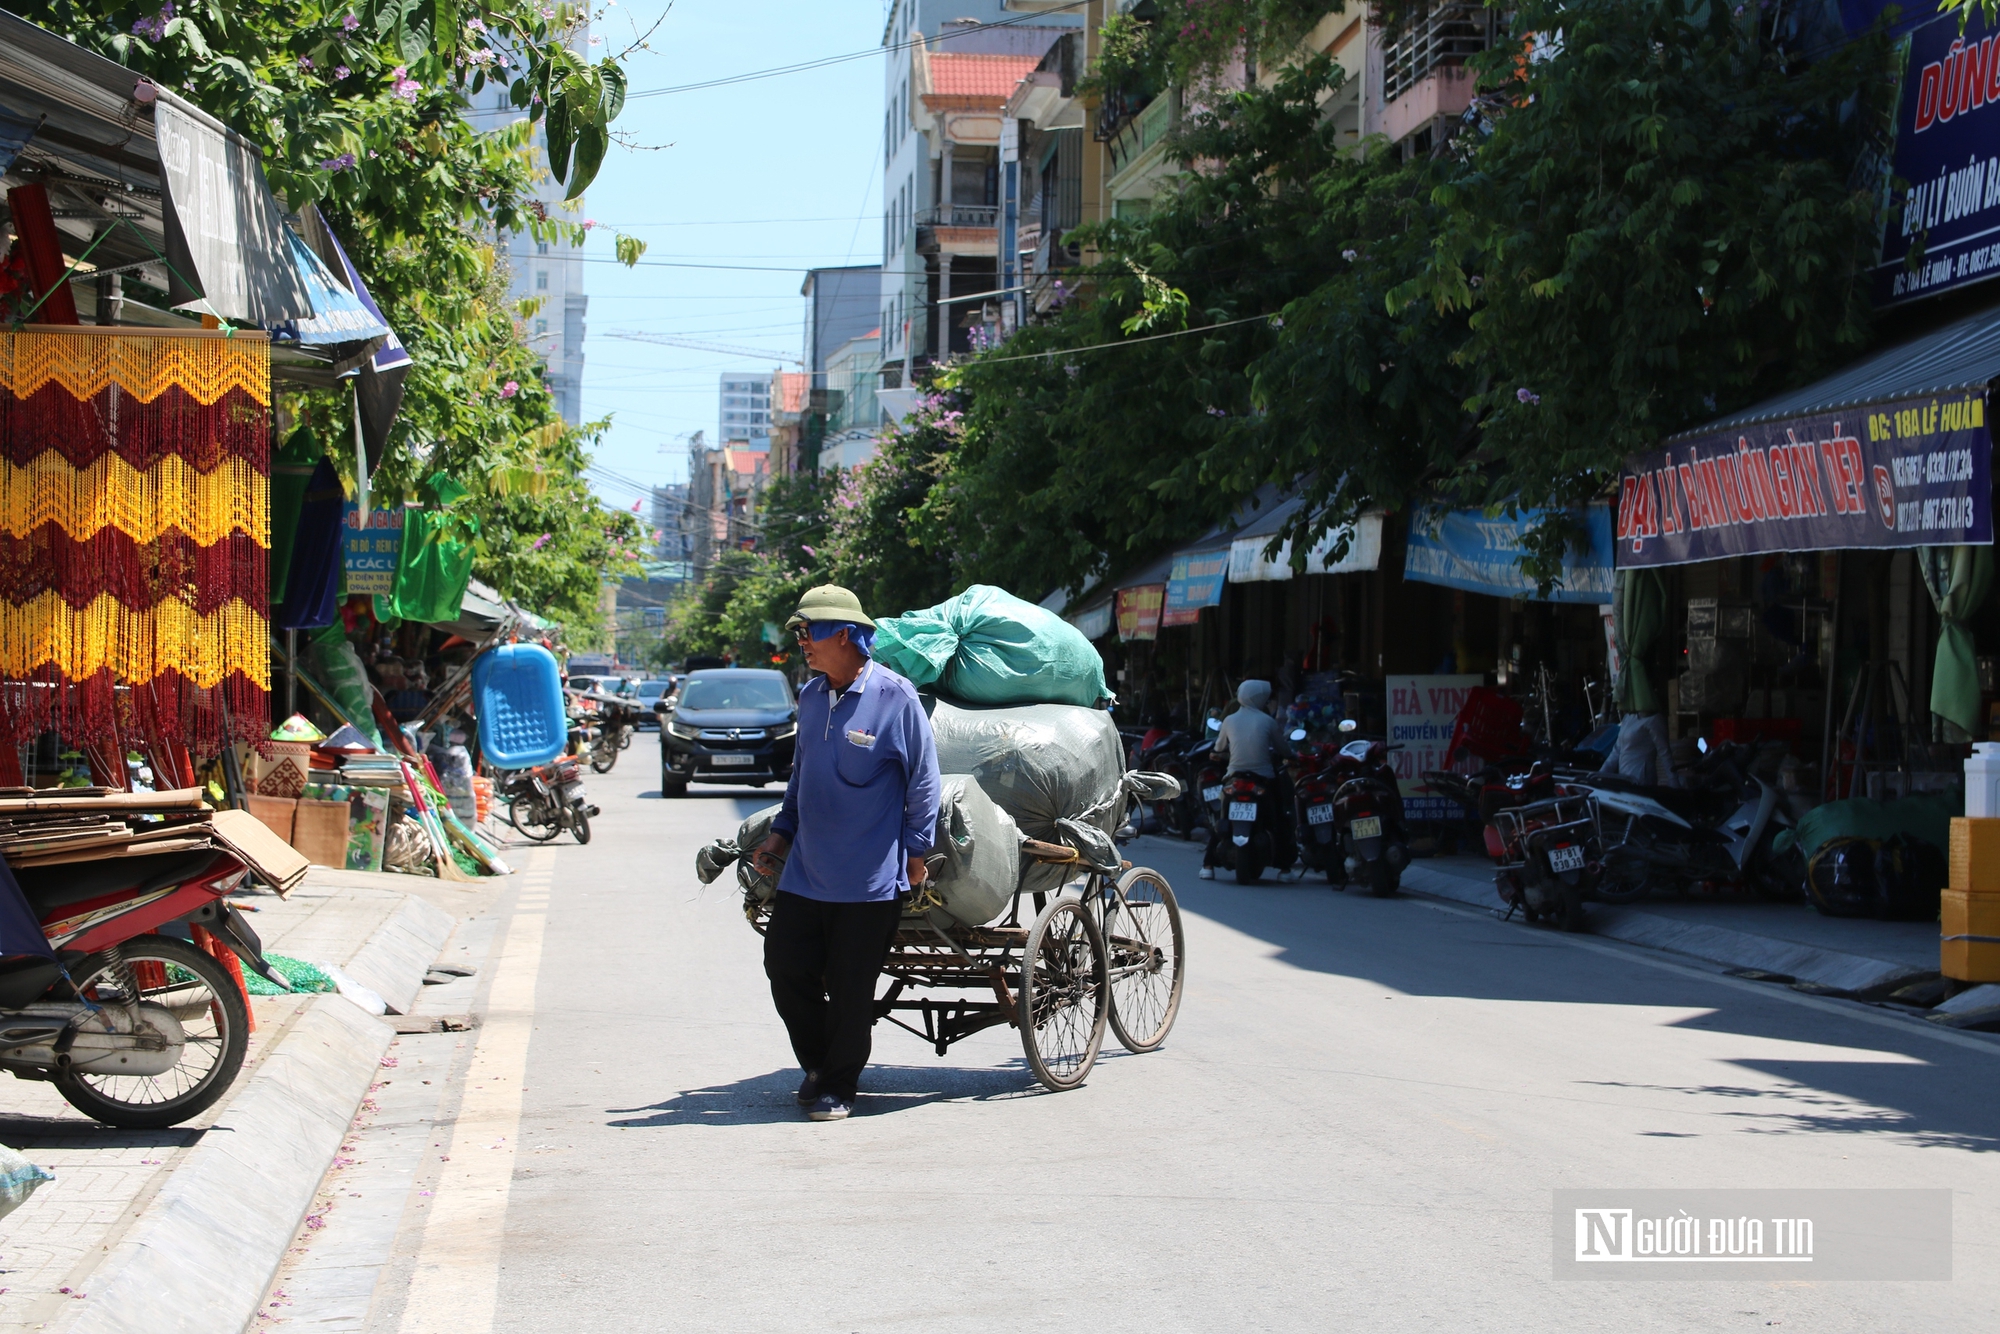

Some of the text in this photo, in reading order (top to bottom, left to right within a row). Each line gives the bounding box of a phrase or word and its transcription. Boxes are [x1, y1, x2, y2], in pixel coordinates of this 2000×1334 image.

[1901, 182, 1929, 245] ĐẠI
[1926, 164, 1947, 229] LÝ
[1944, 154, 1986, 223] BUÔN
[1920, 259, 1932, 289] LÊ
[1894, 408, 1920, 439] 18A
[1922, 398, 1939, 435] LÊ
[1617, 471, 1658, 553] ĐẠI
[1656, 452, 1684, 536] LÝ
[1678, 446, 1722, 531] BÁN
[1768, 427, 1827, 520] GIÀY
[1819, 421, 1867, 515] DÉP
[348, 510, 374, 529] CHN
[376, 511, 390, 529] GA
[356, 557, 385, 569] CÁC
[376, 575, 384, 583] 18
[1392, 681, 1423, 715] HÀ
[1393, 719, 1437, 740] CHUYỂN
[1395, 749, 1413, 779] 20
